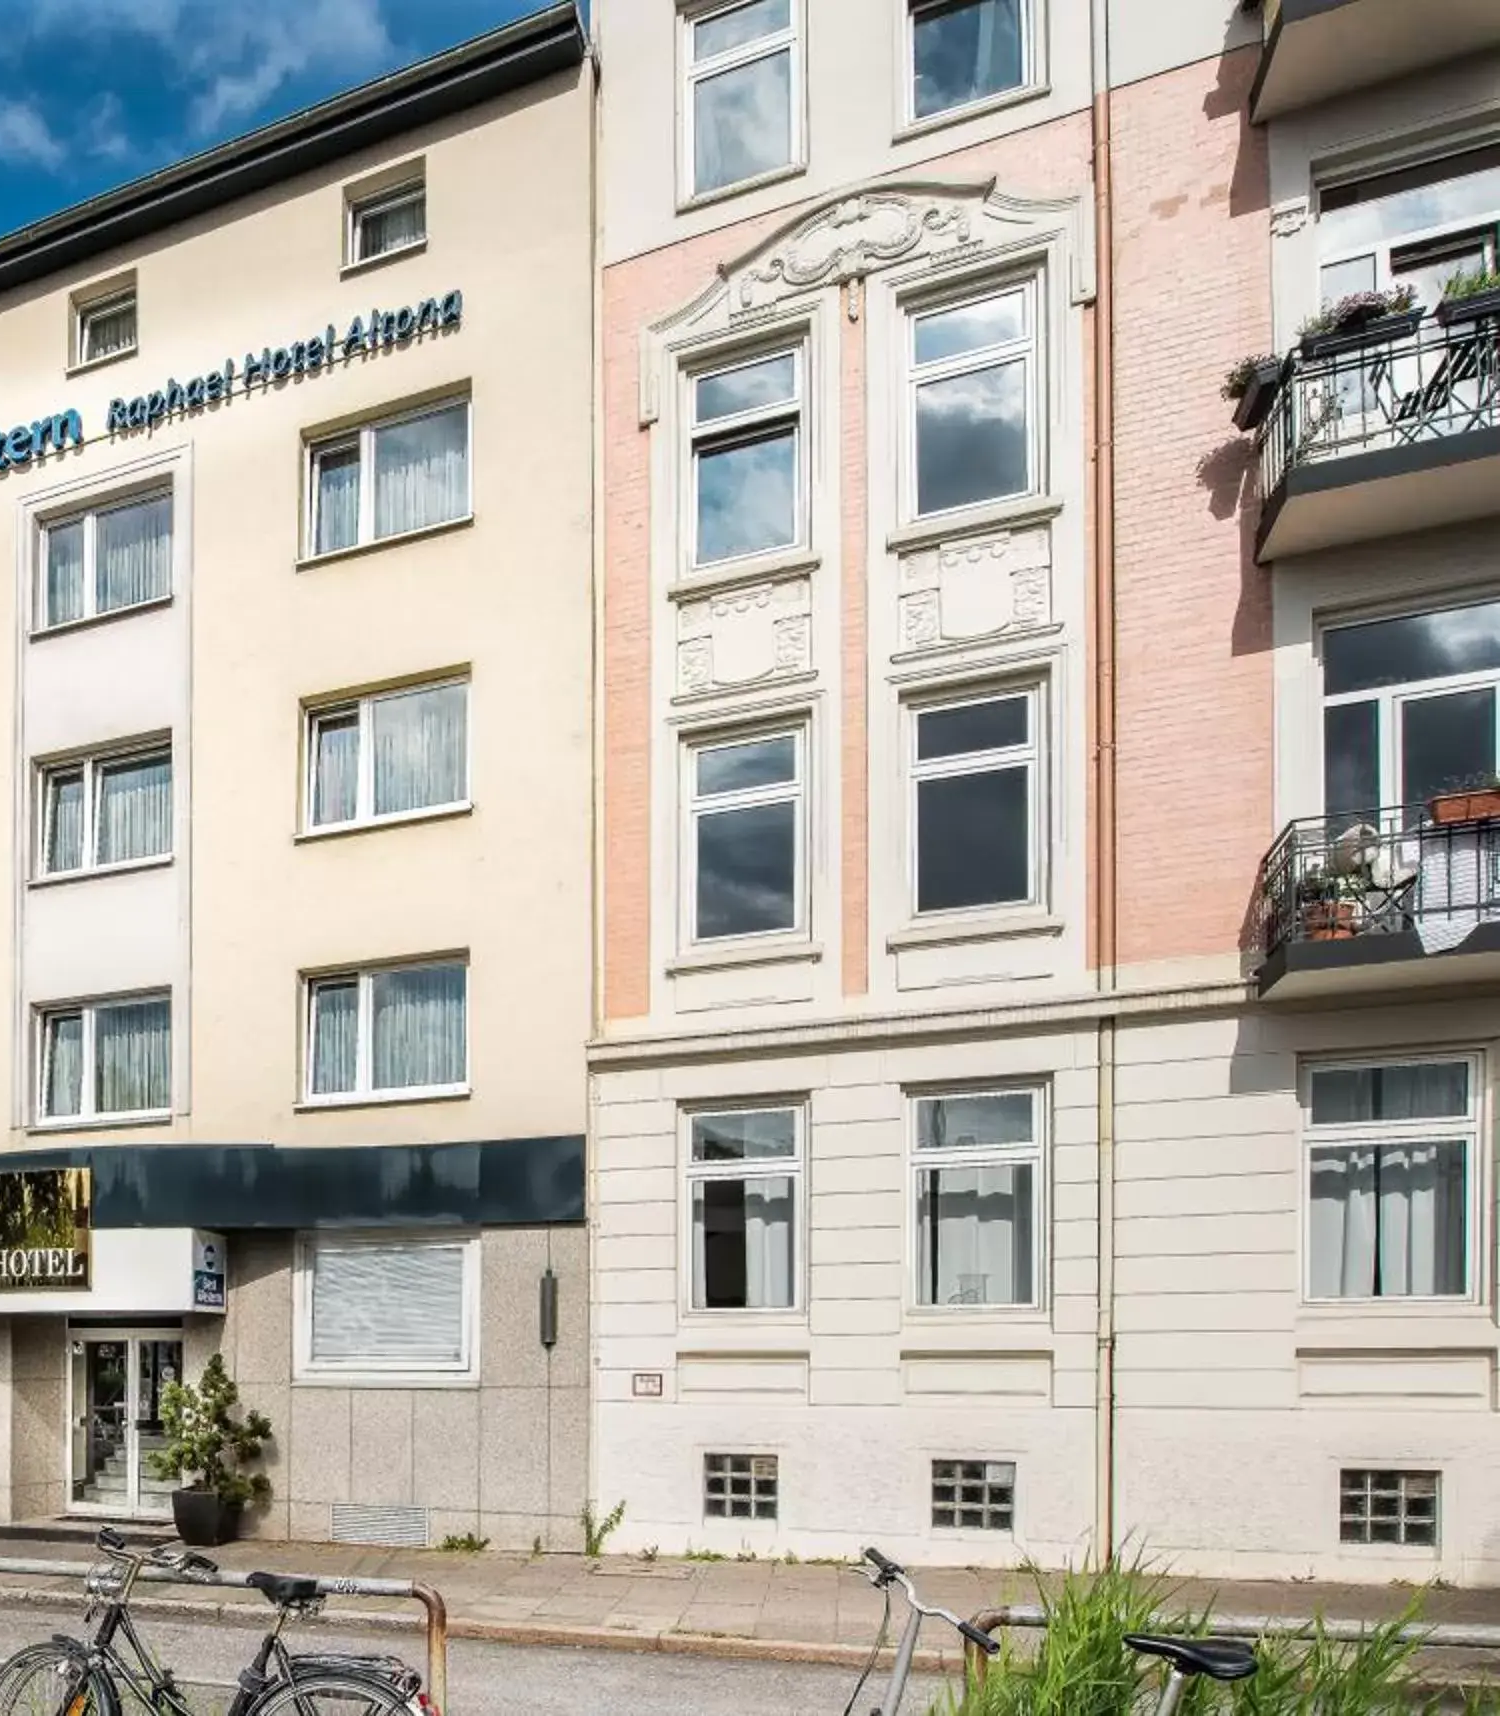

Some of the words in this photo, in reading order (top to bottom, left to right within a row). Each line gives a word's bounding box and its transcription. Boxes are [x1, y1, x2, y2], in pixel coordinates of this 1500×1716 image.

[107, 357, 235, 433] Raphael
[243, 323, 335, 387] Hotel
[342, 288, 463, 354] Altona
